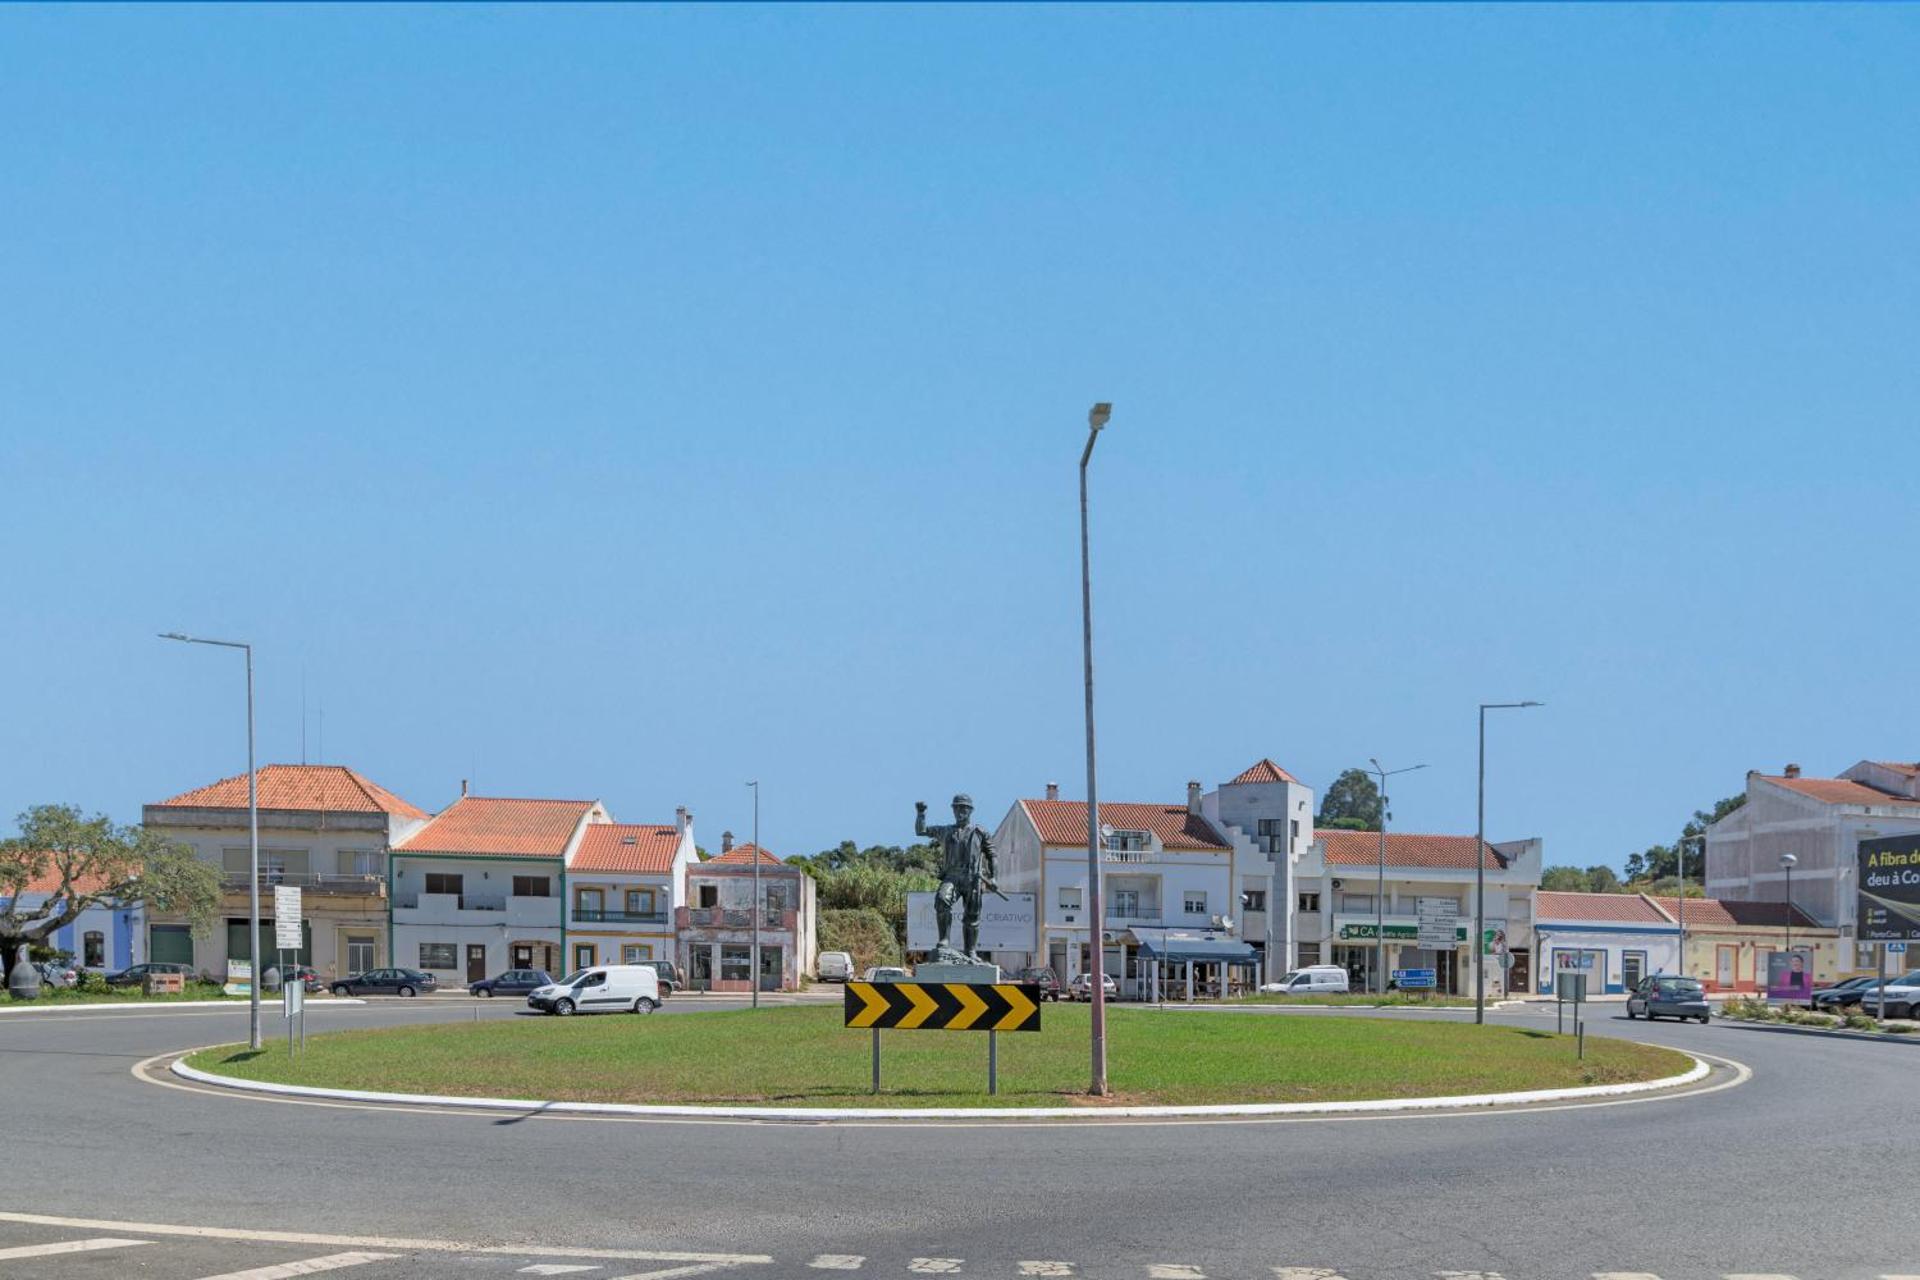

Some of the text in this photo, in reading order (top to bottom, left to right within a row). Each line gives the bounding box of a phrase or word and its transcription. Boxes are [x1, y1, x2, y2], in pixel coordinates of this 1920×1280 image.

[1868, 849, 1920, 867] A fibra d
[1867, 872, 1890, 886] deu
[1360, 926, 1375, 936] CA
